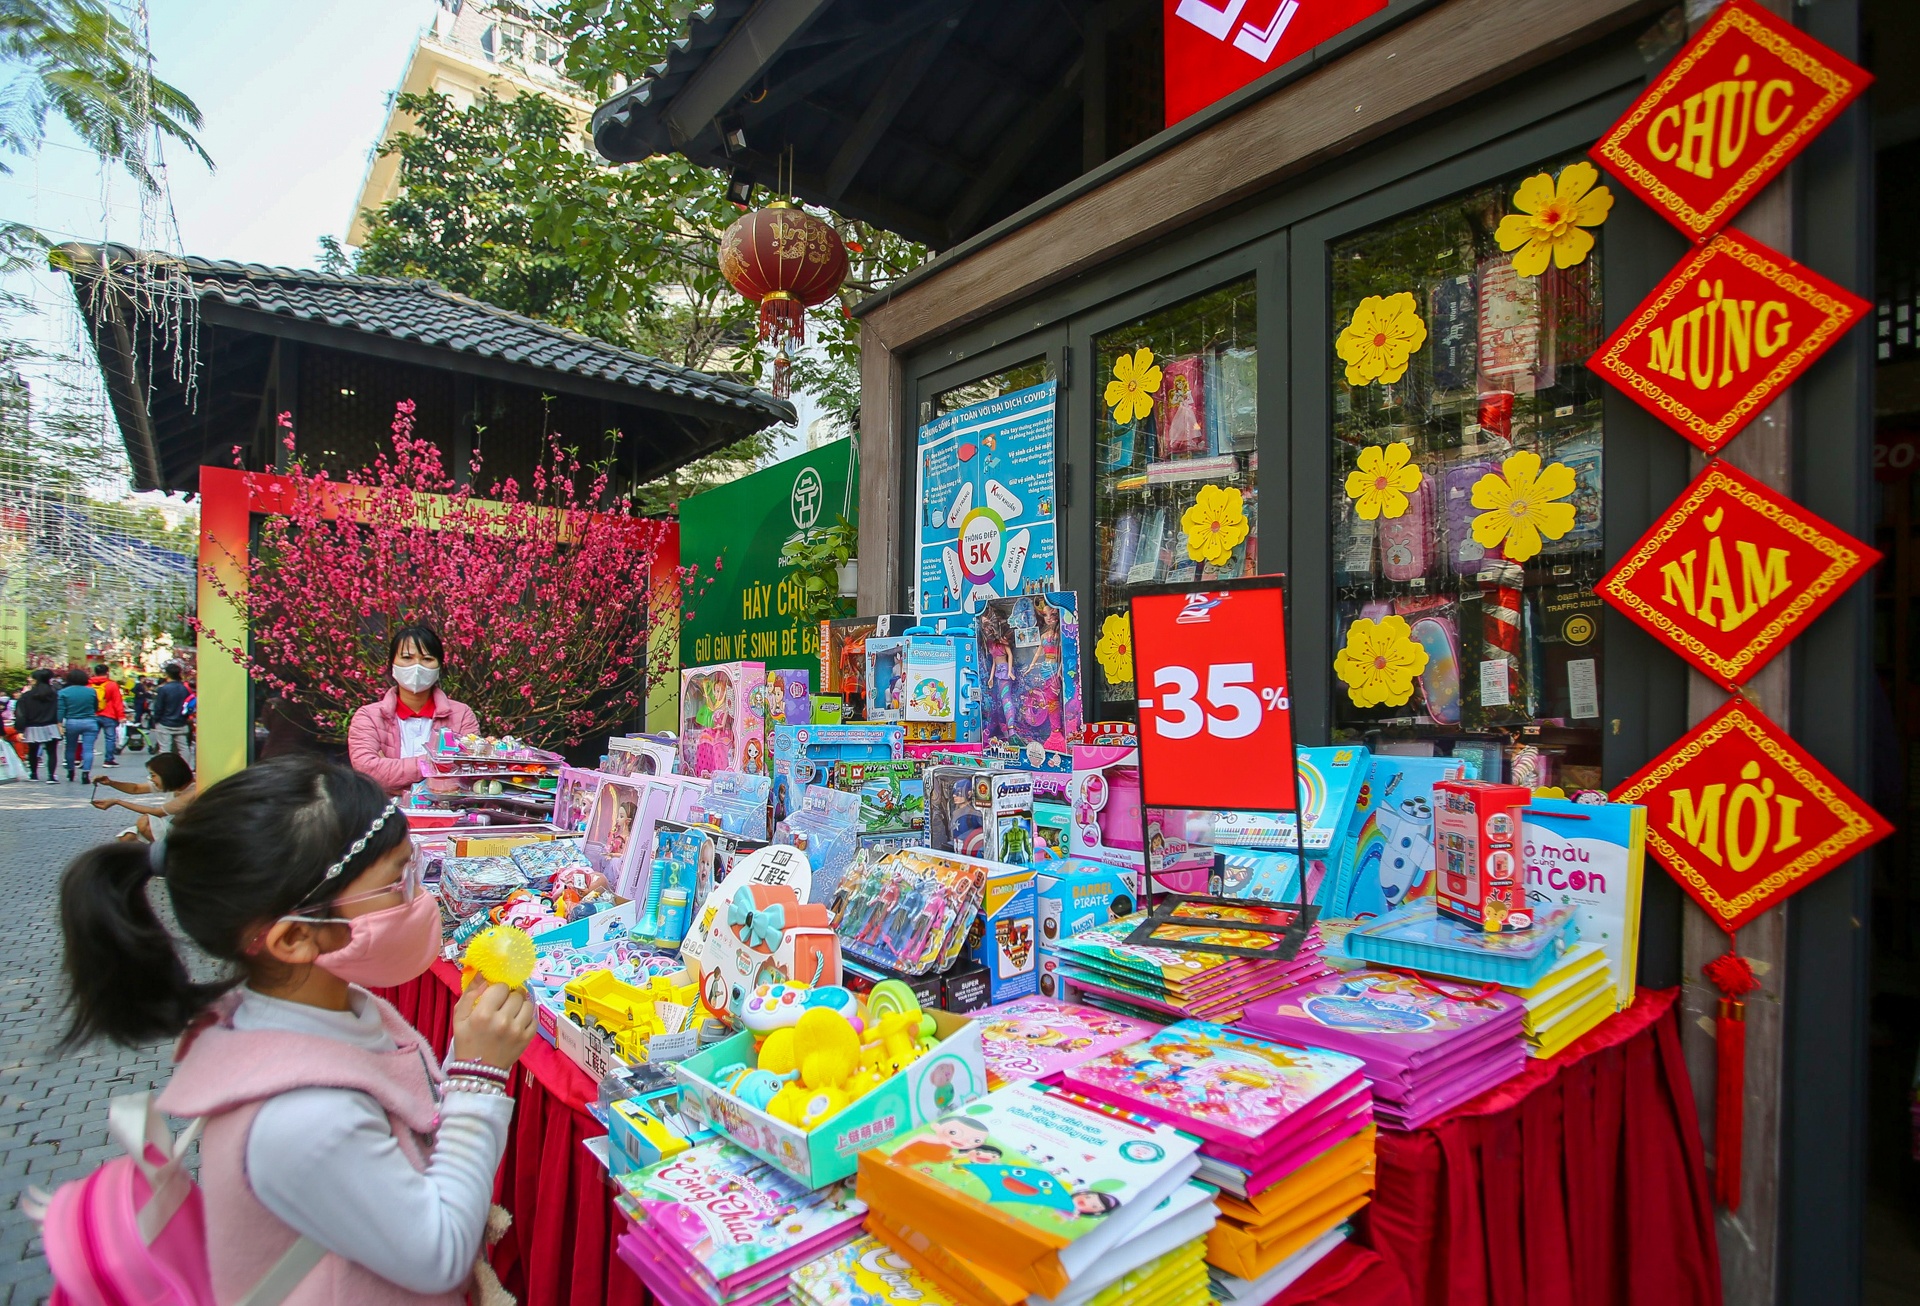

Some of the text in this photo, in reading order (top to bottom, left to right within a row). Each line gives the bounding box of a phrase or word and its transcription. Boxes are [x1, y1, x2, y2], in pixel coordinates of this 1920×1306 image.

[1647, 53, 1795, 179] CHÚC
[1647, 279, 1793, 391] MỪNG
[921, 387, 1056, 439] CHUNG SỐNG AN TOÀN VỚI ĐẠI DỊCH COVID-19
[965, 529, 998, 543] THÔNG ĐIỆP
[970, 541, 992, 565] 5K
[1013, 546, 1026, 574] KHÔNG
[1659, 506, 1793, 632] NĂM
[743, 580, 772, 620] HÃY
[1547, 602, 1578, 612] TRAFFIC
[1557, 590, 1596, 601] OBER THE
[695, 632, 711, 662] GIỮ
[714, 630, 731, 660] GÌN
[751, 629, 777, 659] SINH
[782, 617, 798, 656] ĐỂ
[1571, 625, 1587, 634] GO
[1138, 662, 1290, 740] -35%
[864, 764, 909, 773] MY WRLD
[1667, 760, 1803, 873] MỚI
[1524, 840, 1590, 863] ô màu
[1533, 858, 1555, 868] cùng
[1072, 882, 1114, 899] BARREL
[1548, 868, 1606, 894] con
[1074, 894, 1110, 909] PIRATE
[1073, 916, 1094, 933] LUCKY
[962, 979, 979, 989] SUPER
[657, 1163, 758, 1245] Công Chúa
